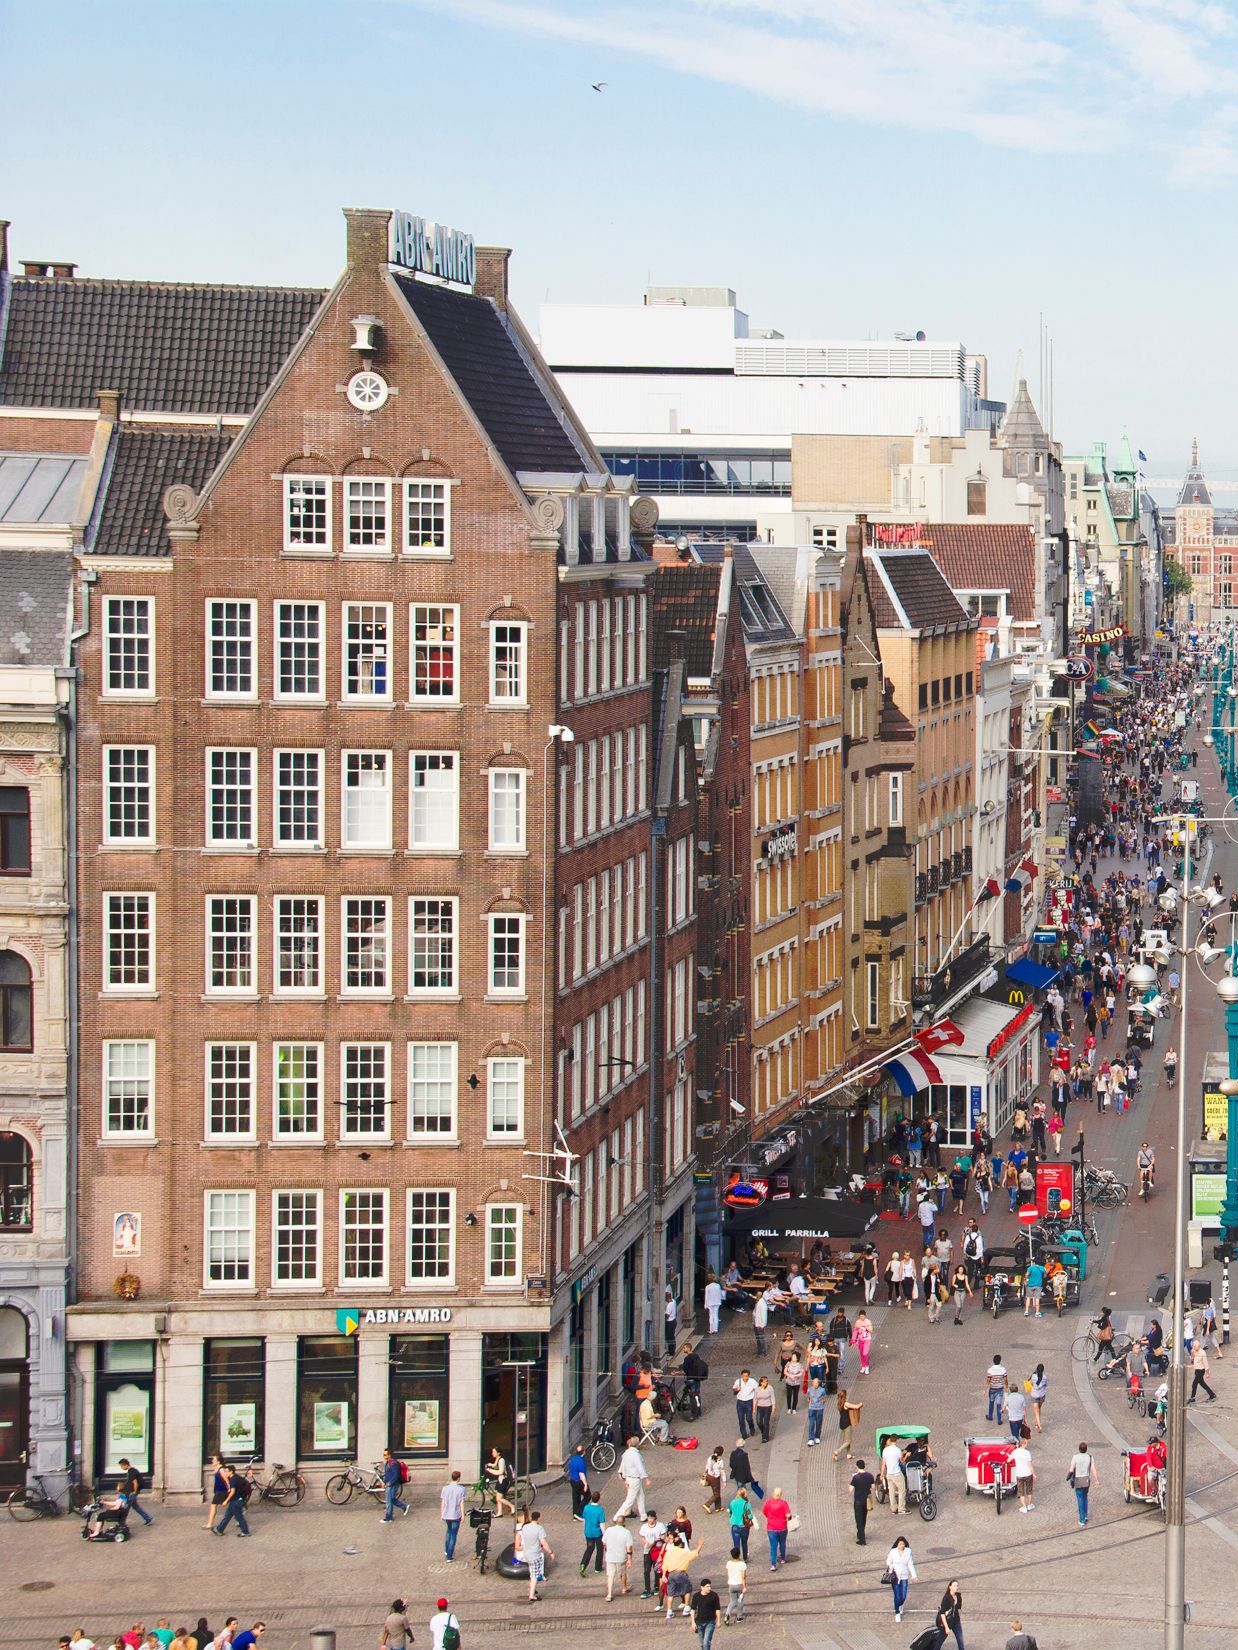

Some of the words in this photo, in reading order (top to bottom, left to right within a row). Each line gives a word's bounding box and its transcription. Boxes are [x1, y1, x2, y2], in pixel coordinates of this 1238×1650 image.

[1078, 627, 1123, 643] CASINO
[1067, 661, 1088, 675] C&A
[751, 1229, 779, 1237] GRILL
[785, 1229, 830, 1238] PARRILLA
